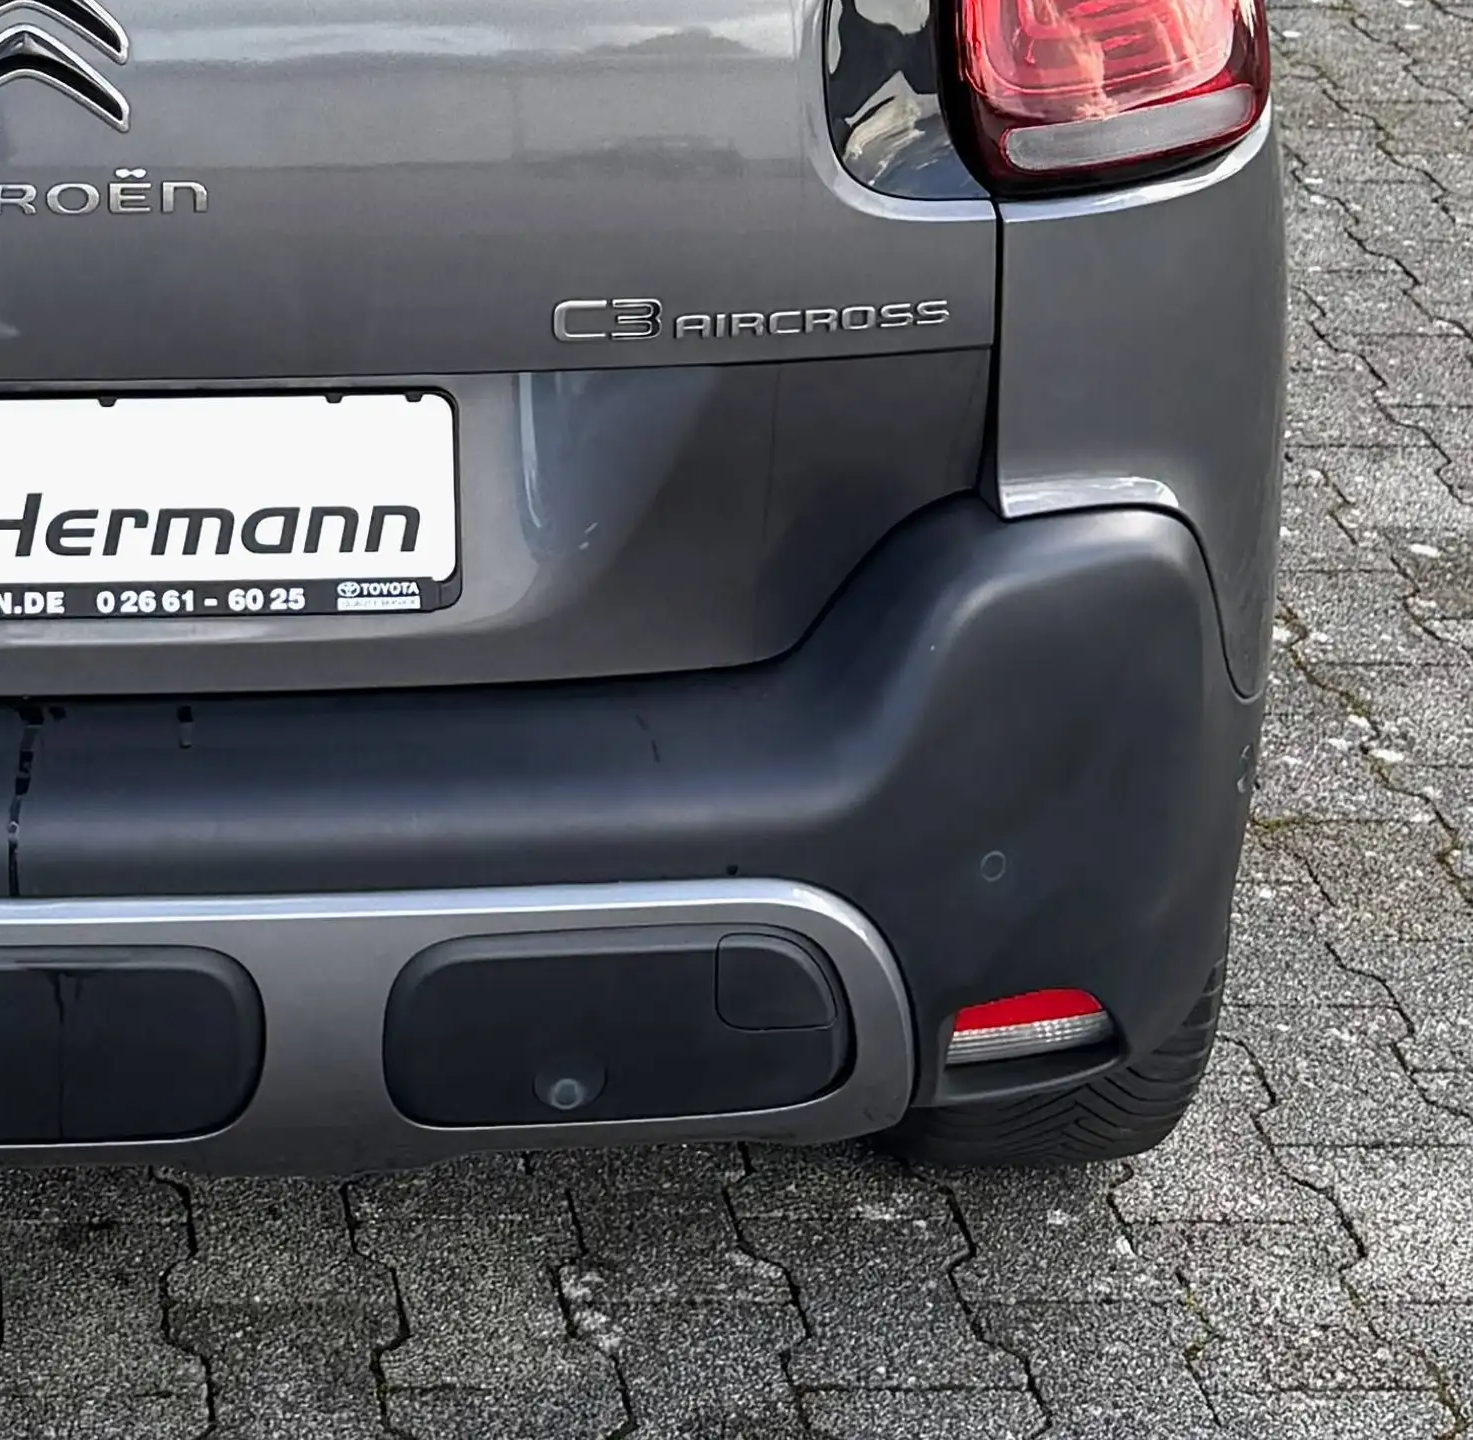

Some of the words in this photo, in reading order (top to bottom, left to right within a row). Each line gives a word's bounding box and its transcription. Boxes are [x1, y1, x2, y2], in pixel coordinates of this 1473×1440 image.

[553, 298, 663, 342] C3
[675, 300, 950, 340] AIRCROSS
[361, 581, 420, 595] TOYOTA
